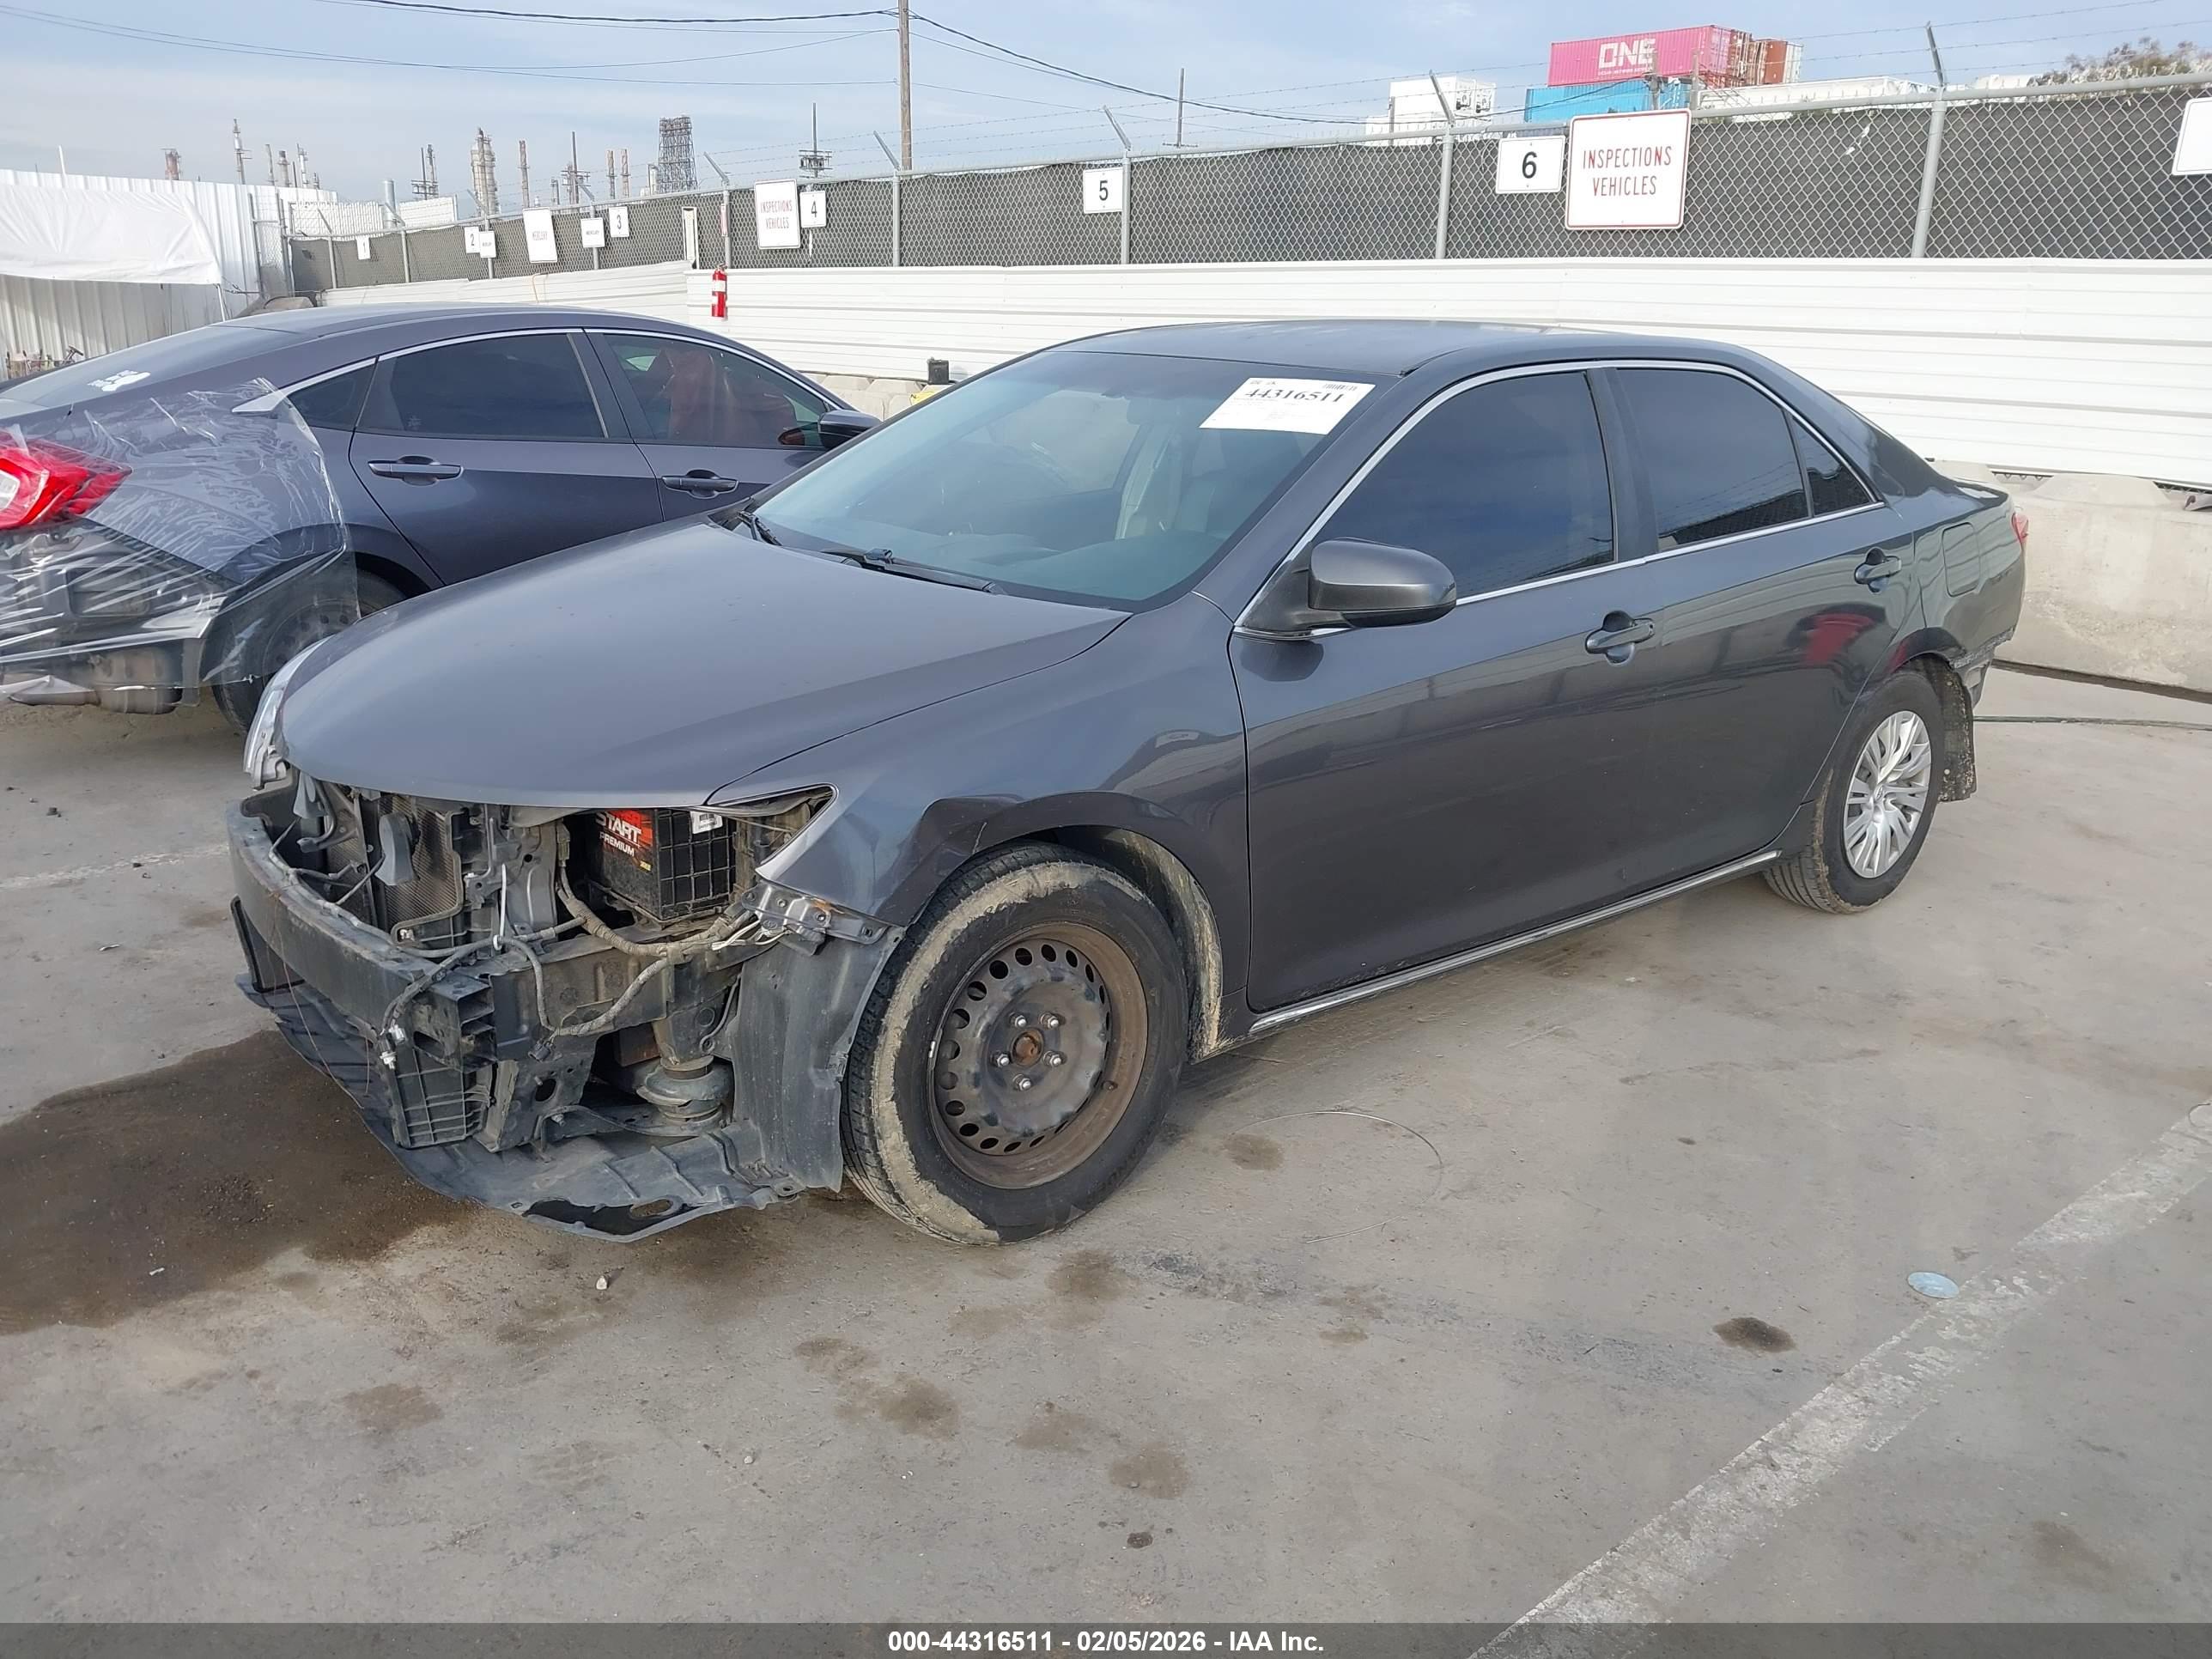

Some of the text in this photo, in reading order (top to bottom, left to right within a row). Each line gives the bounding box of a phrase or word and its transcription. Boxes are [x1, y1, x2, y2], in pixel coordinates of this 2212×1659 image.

[1599, 39, 1656, 69] ONE
[1522, 151, 1538, 179] 6
[1583, 145, 1673, 169] INSPECTIONS
[1099, 180, 1109, 201] 5
[1592, 175, 1657, 197] VEHICLES
[760, 200, 793, 214] INSPECTIONS
[811, 200, 817, 218] 4
[617, 215, 623, 230] 3
[765, 216, 789, 229] VEHICLES
[470, 233, 475, 246] 2
[1245, 388, 1344, 403] 44316511
[596, 811, 641, 843] START
[600, 830, 635, 857] PREMIUM
